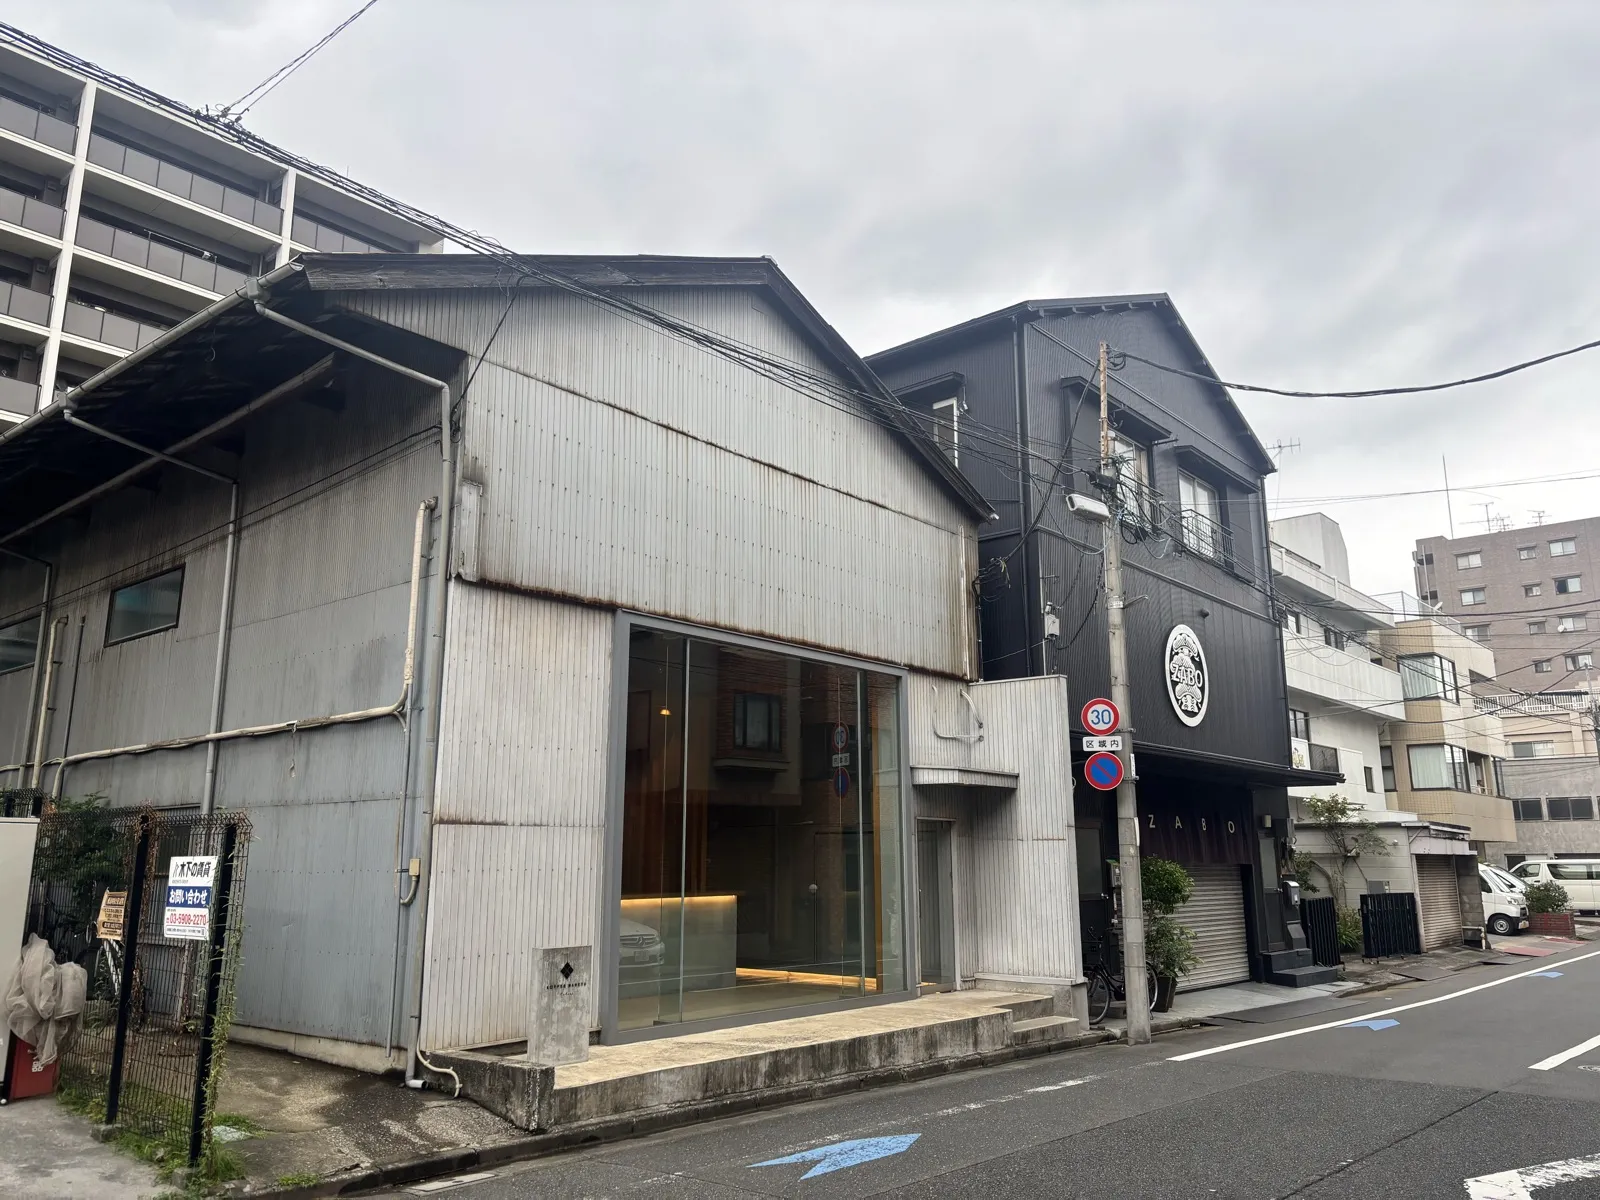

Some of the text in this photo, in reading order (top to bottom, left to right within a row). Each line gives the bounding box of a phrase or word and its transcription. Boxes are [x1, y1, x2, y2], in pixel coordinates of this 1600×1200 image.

[1171, 663, 1203, 688] ZABO
[1091, 709, 1111, 725] 30
[1086, 740, 1119, 748] 区域内
[1148, 814, 1235, 833] ZABO
[169, 889, 208, 905] お問い合わせ
